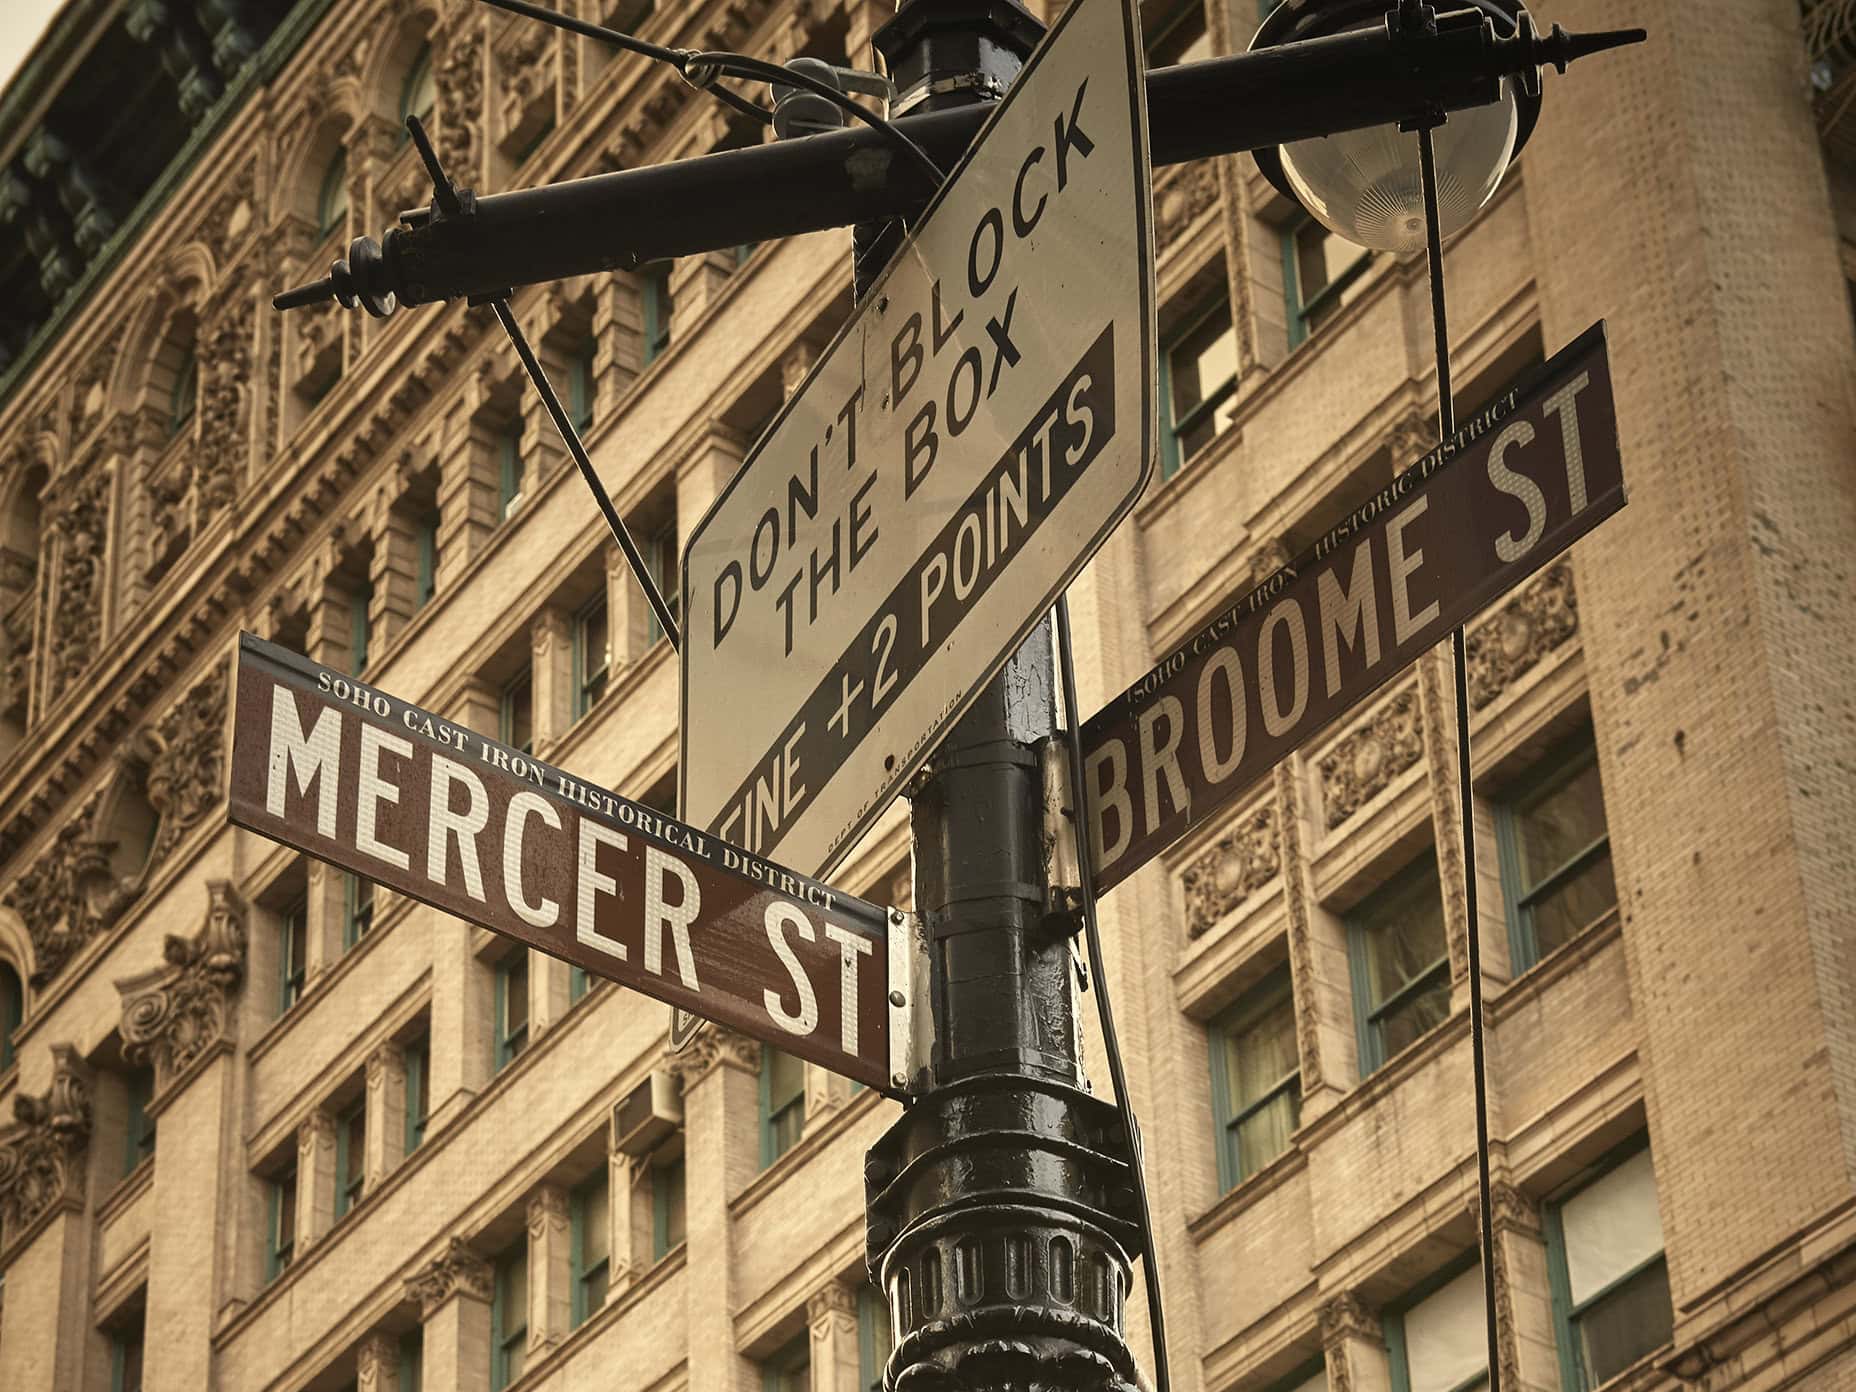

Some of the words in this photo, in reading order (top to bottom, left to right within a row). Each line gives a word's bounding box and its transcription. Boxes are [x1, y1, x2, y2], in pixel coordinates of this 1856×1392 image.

[714, 385, 865, 648] DON'T
[892, 77, 1095, 405] BLOCK
[776, 470, 878, 658] THE
[905, 290, 1022, 501] BOX
[1132, 651, 1186, 702] SOHO
[1193, 610, 1242, 655] CAST
[1249, 566, 1298, 614] IRON
[1314, 472, 1415, 561] HISTORIC
[1421, 387, 1520, 480] DISTRICT
[827, 614, 898, 739] +2
[922, 373, 1093, 648] POINTS
[1085, 494, 1440, 871] BROOME
[1487, 370, 1589, 564] ST
[265, 683, 702, 992] MERCER
[763, 900, 873, 1057] ST
[318, 670, 392, 719] SOHO
[403, 708, 470, 751] CAST
[481, 741, 546, 788] IRON
[556, 777, 712, 859] HISTORICAL
[721, 845, 837, 911] DISTRICT
[827, 822, 853, 854] DEPT
[857, 800, 869, 818] OF
[874, 690, 963, 797] TRANSPORTATION
